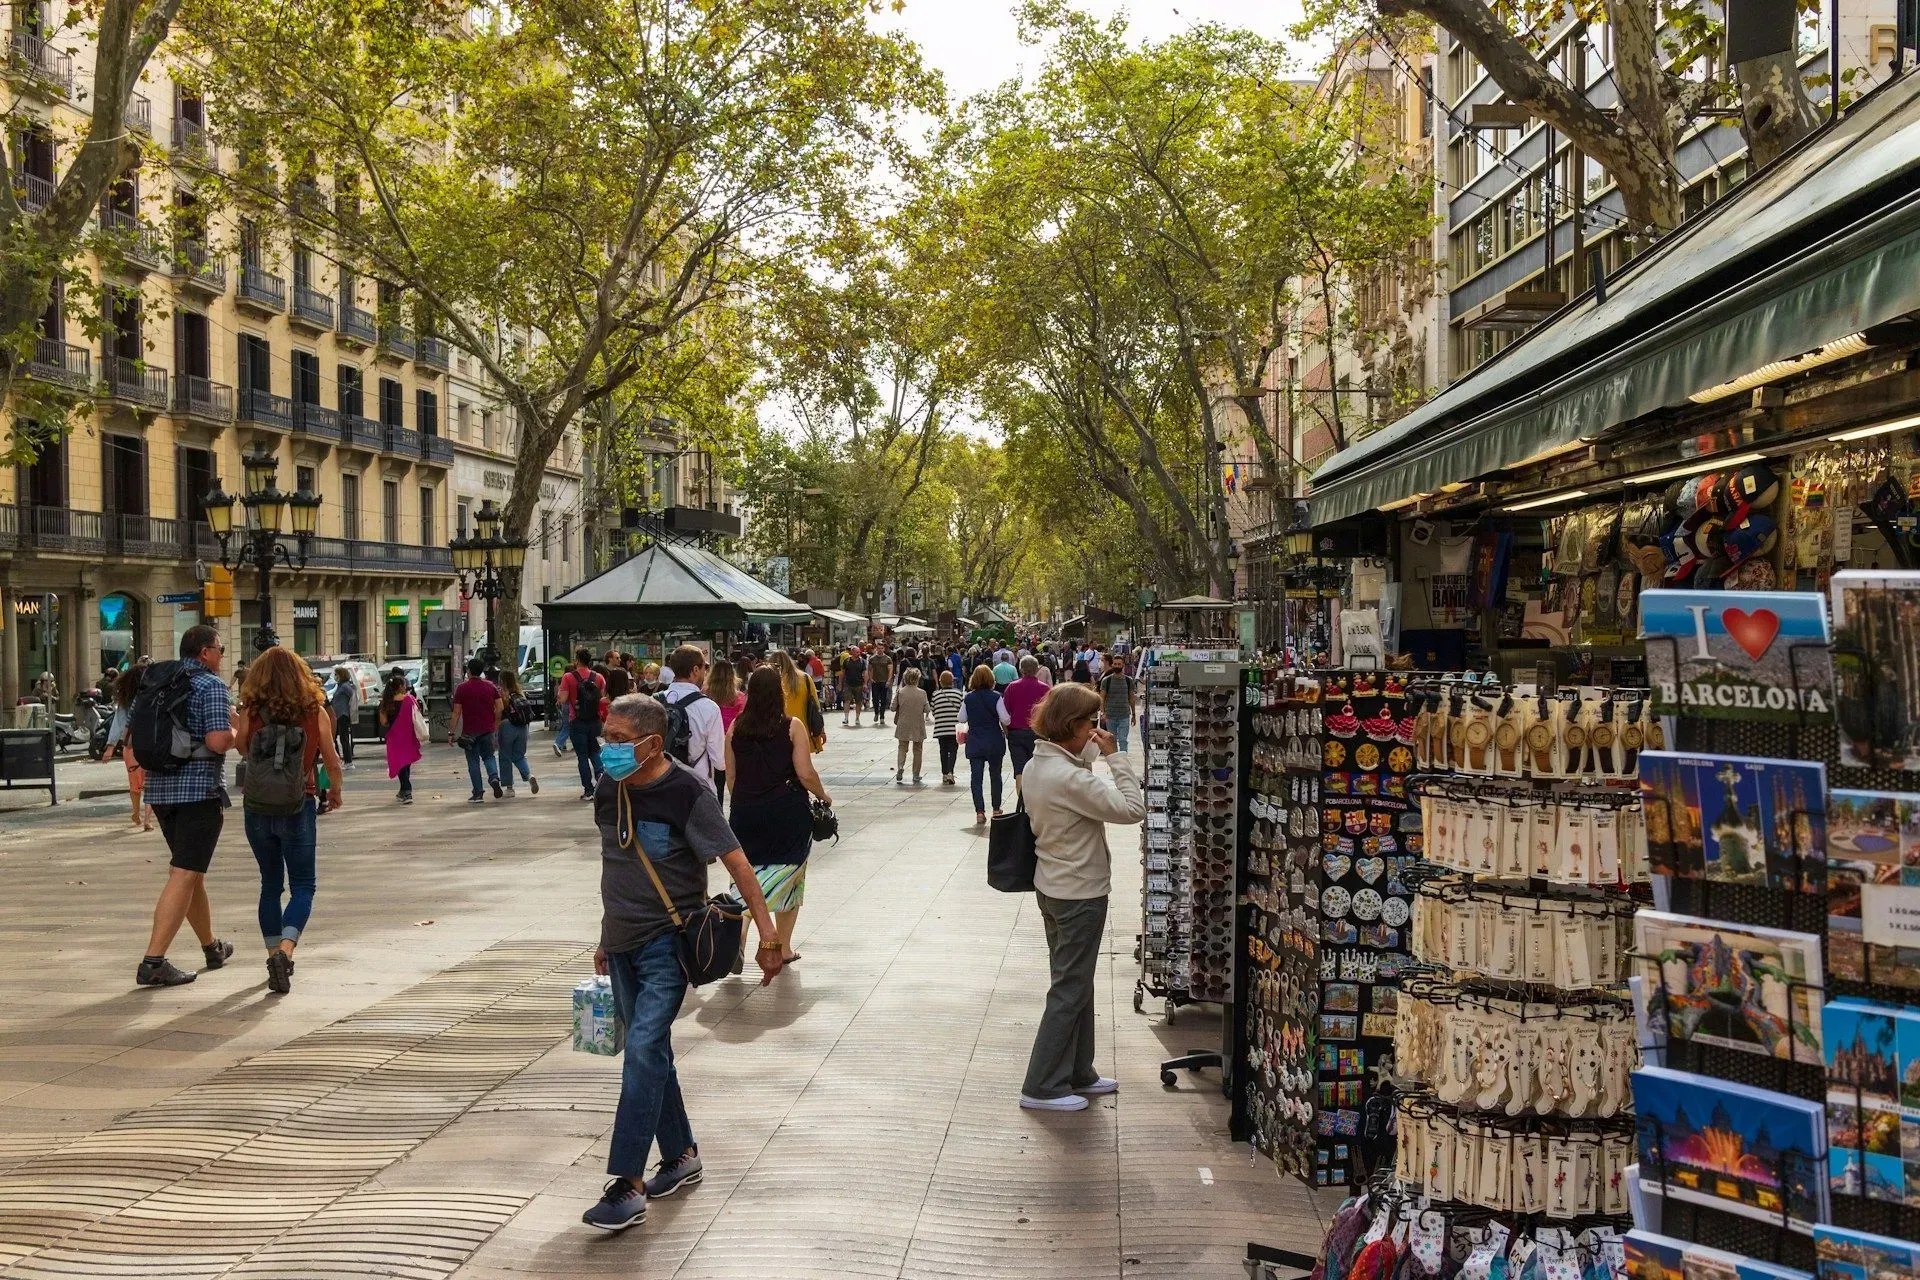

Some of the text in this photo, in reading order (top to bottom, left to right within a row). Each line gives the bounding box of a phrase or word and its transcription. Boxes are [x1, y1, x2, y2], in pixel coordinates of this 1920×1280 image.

[15, 602, 40, 614] MAN
[1685, 605, 1717, 660] I
[1659, 682, 1829, 713] BARCELONA
